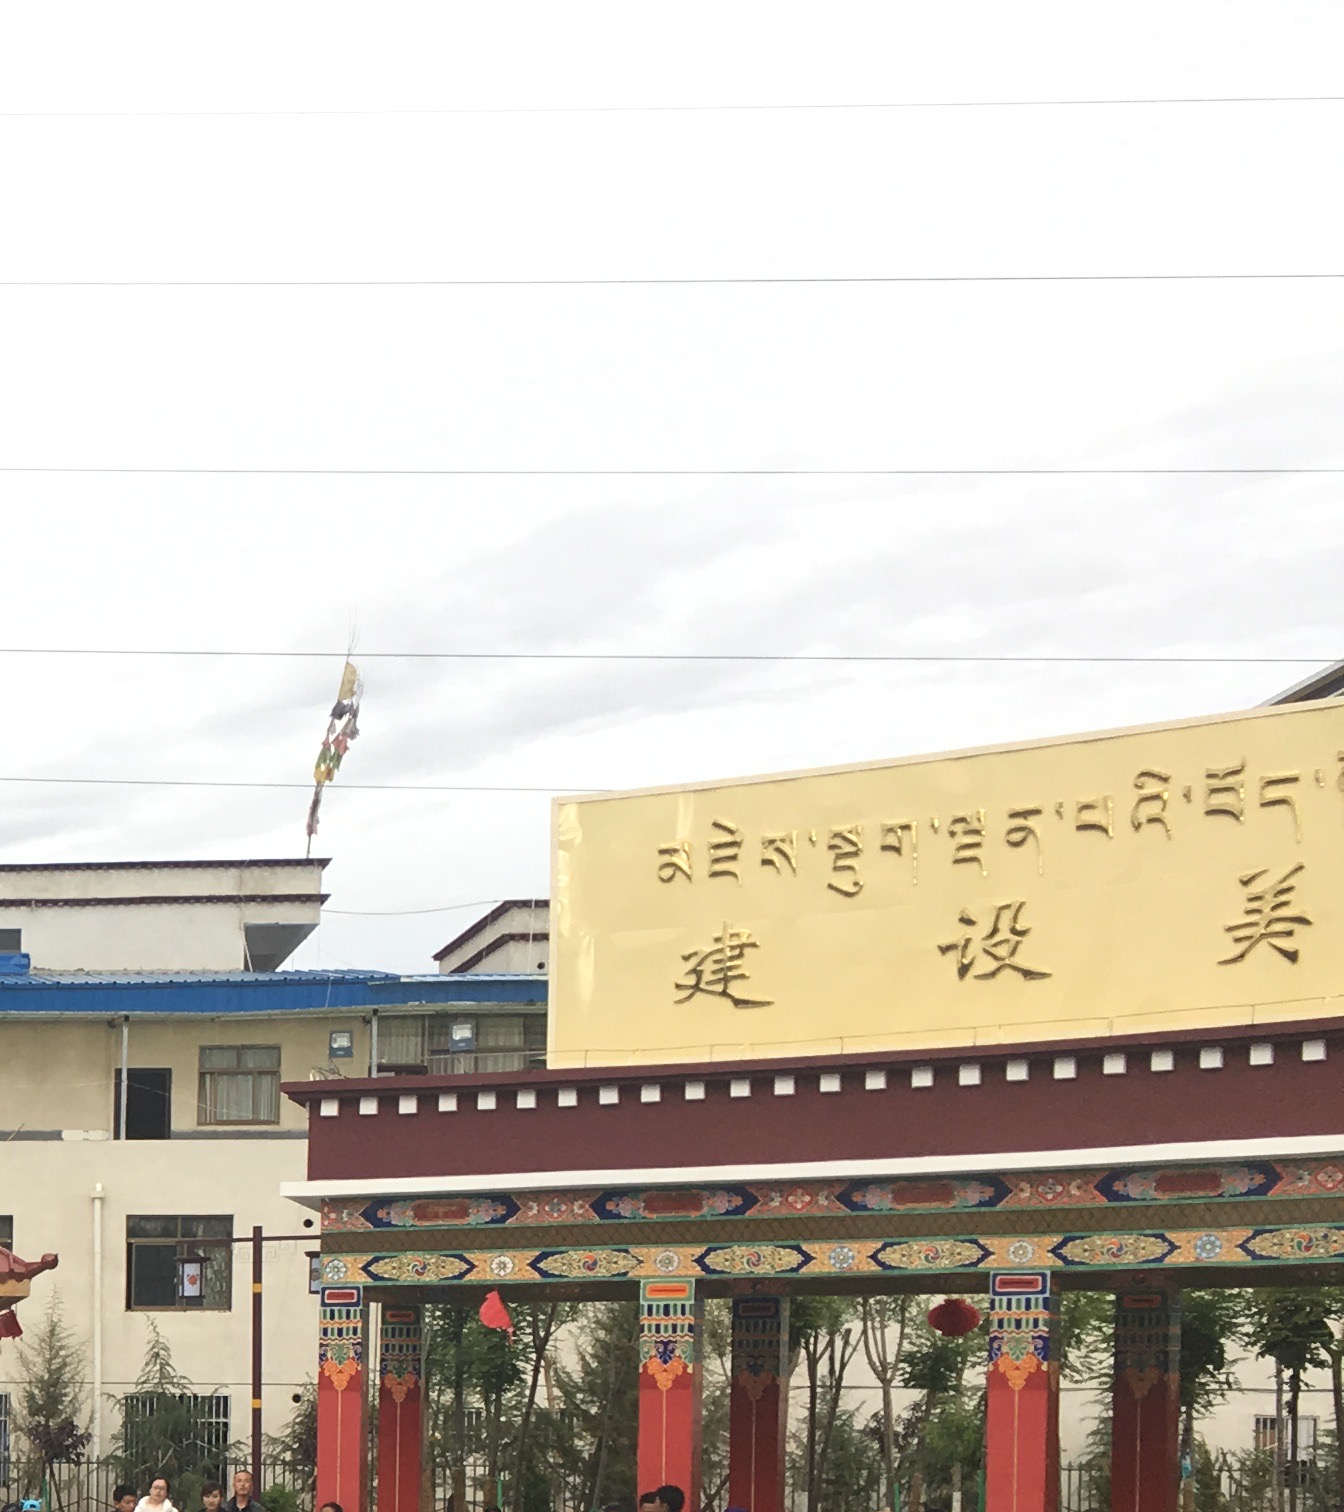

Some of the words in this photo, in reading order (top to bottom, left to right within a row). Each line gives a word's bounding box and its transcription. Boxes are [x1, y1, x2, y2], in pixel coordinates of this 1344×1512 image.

[658, 750, 1344, 899] མཛེས་སྡུག་ལྡན་པའི་བོད་
[673, 862, 1314, 1009] 建设美
